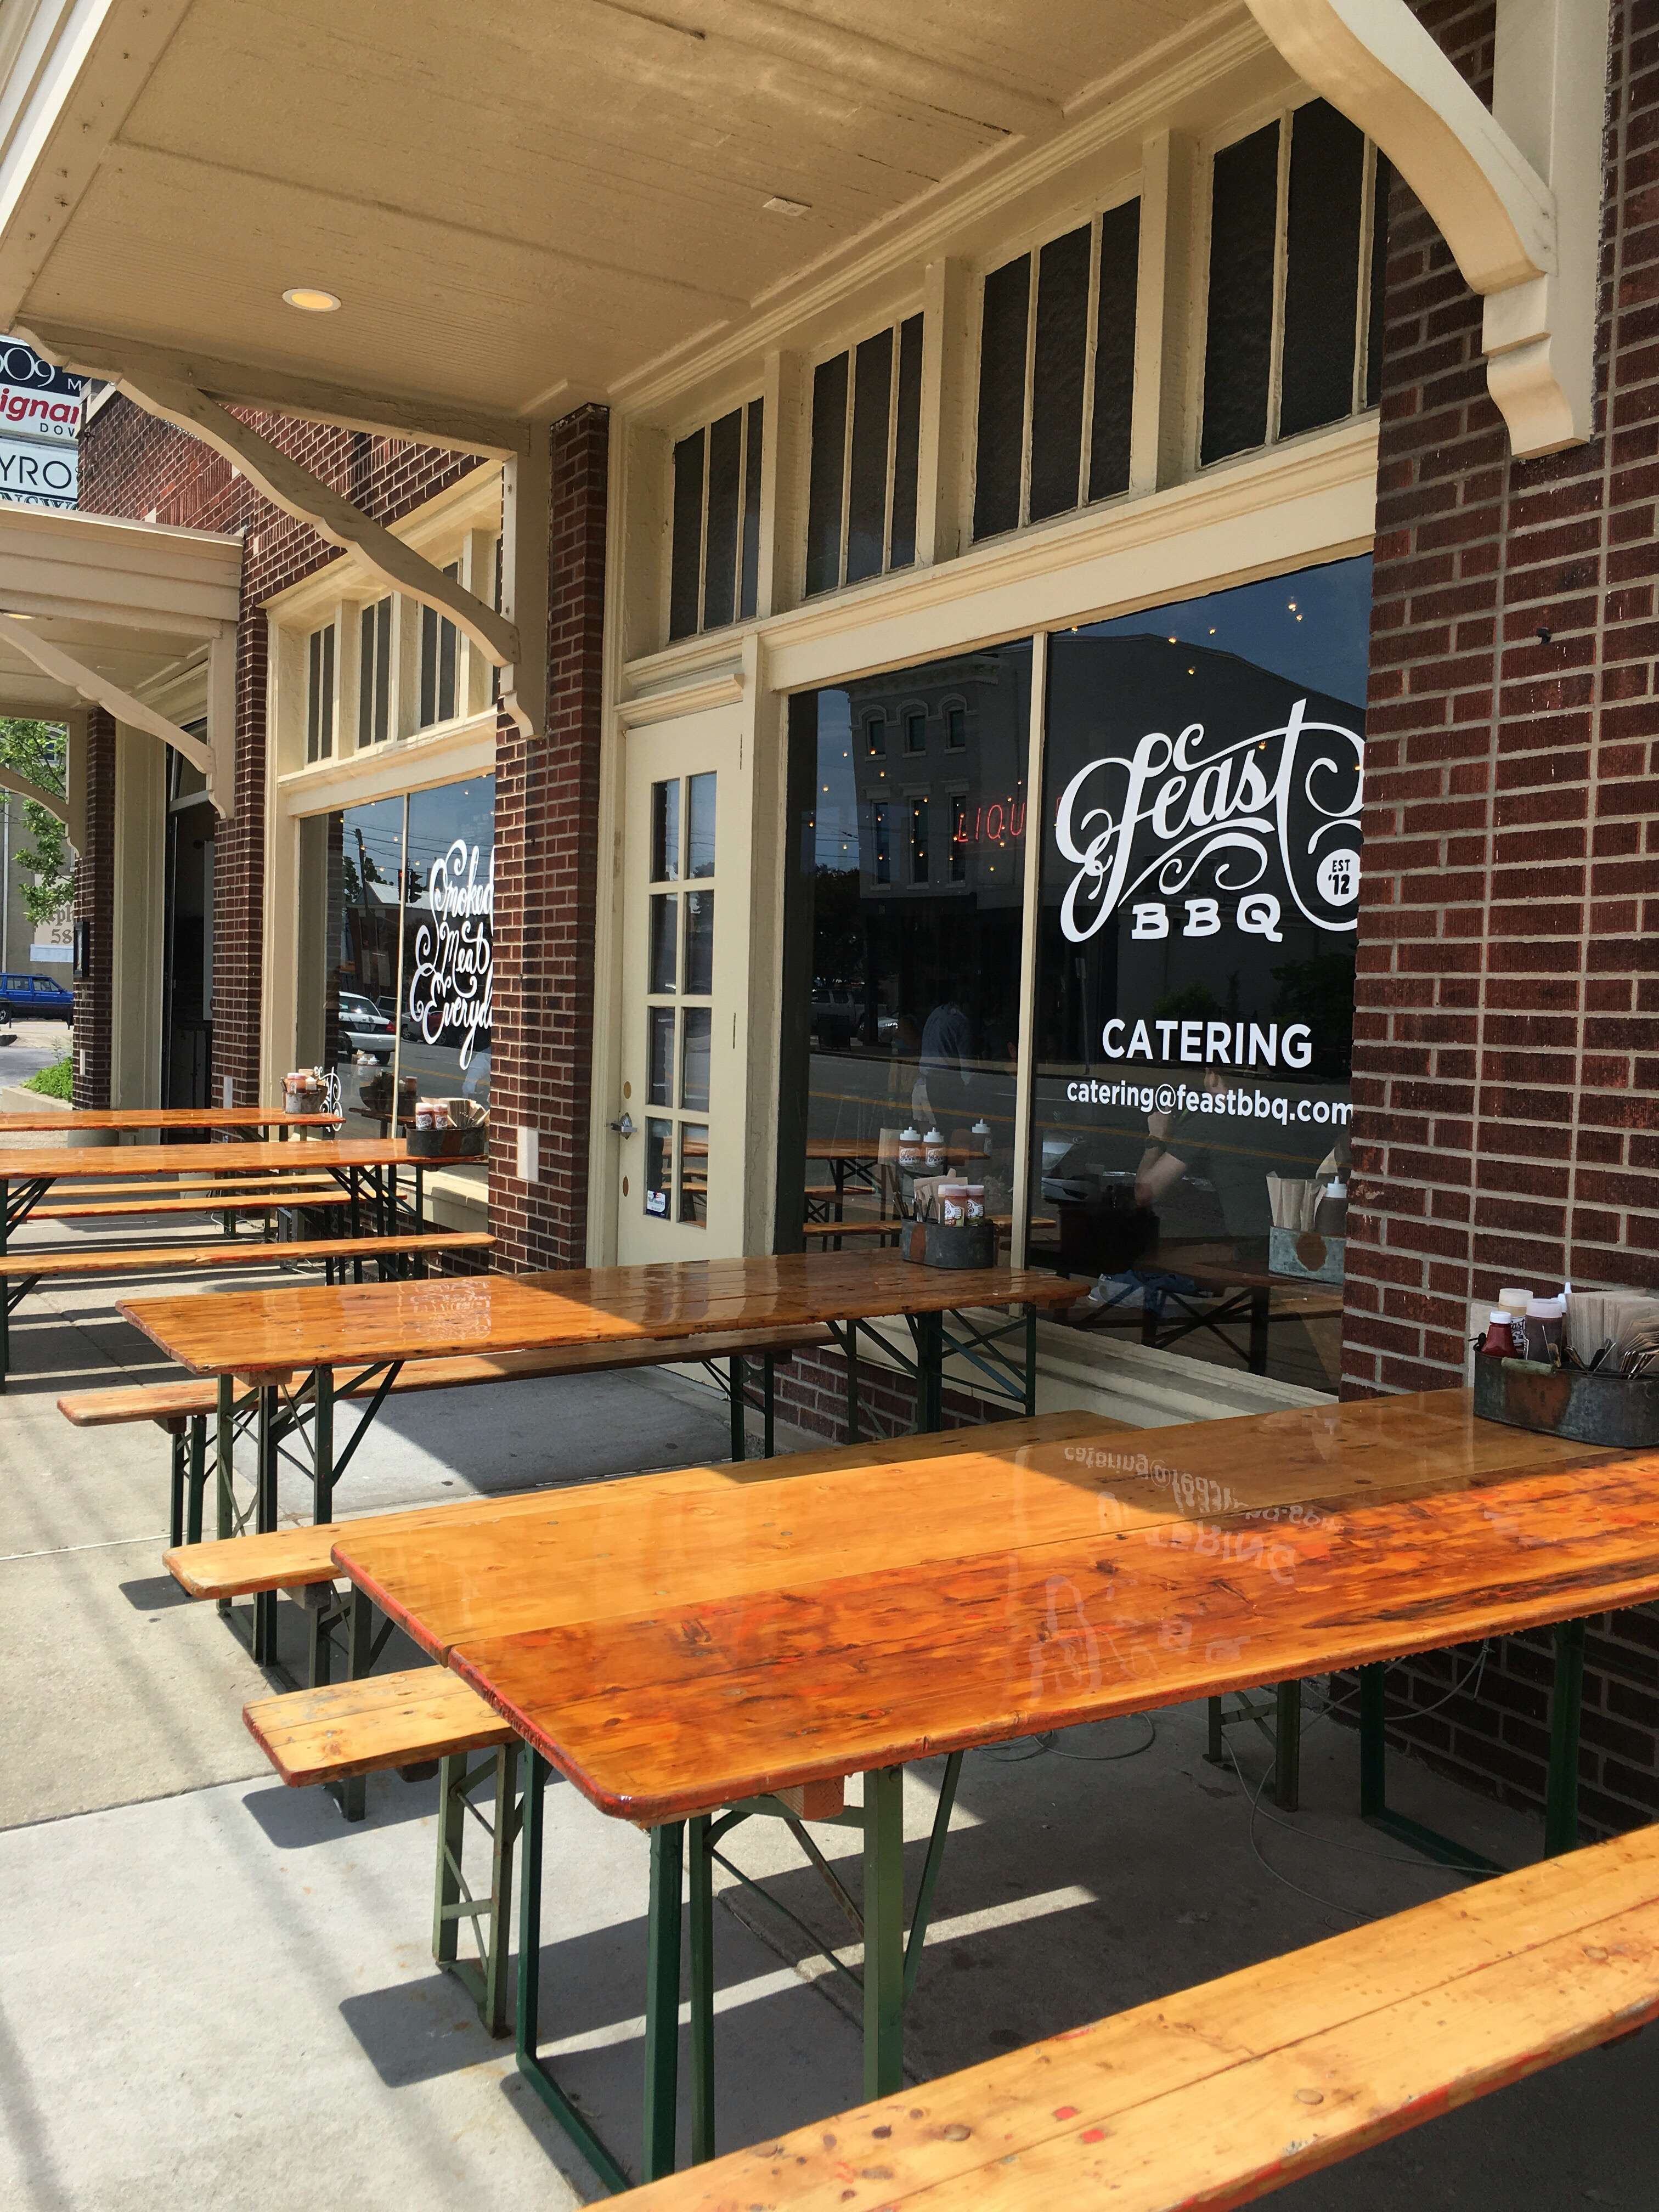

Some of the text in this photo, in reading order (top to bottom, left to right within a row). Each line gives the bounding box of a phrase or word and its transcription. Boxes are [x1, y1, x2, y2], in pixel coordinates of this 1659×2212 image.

[1056, 698, 1365, 942] Feast
[1328, 874, 1350, 895] '12
[1332, 859, 1351, 873] EST
[1131, 893, 1283, 943] BBQ
[439, 921, 490, 998] Meat
[1102, 1018, 1312, 1068] CATERING
